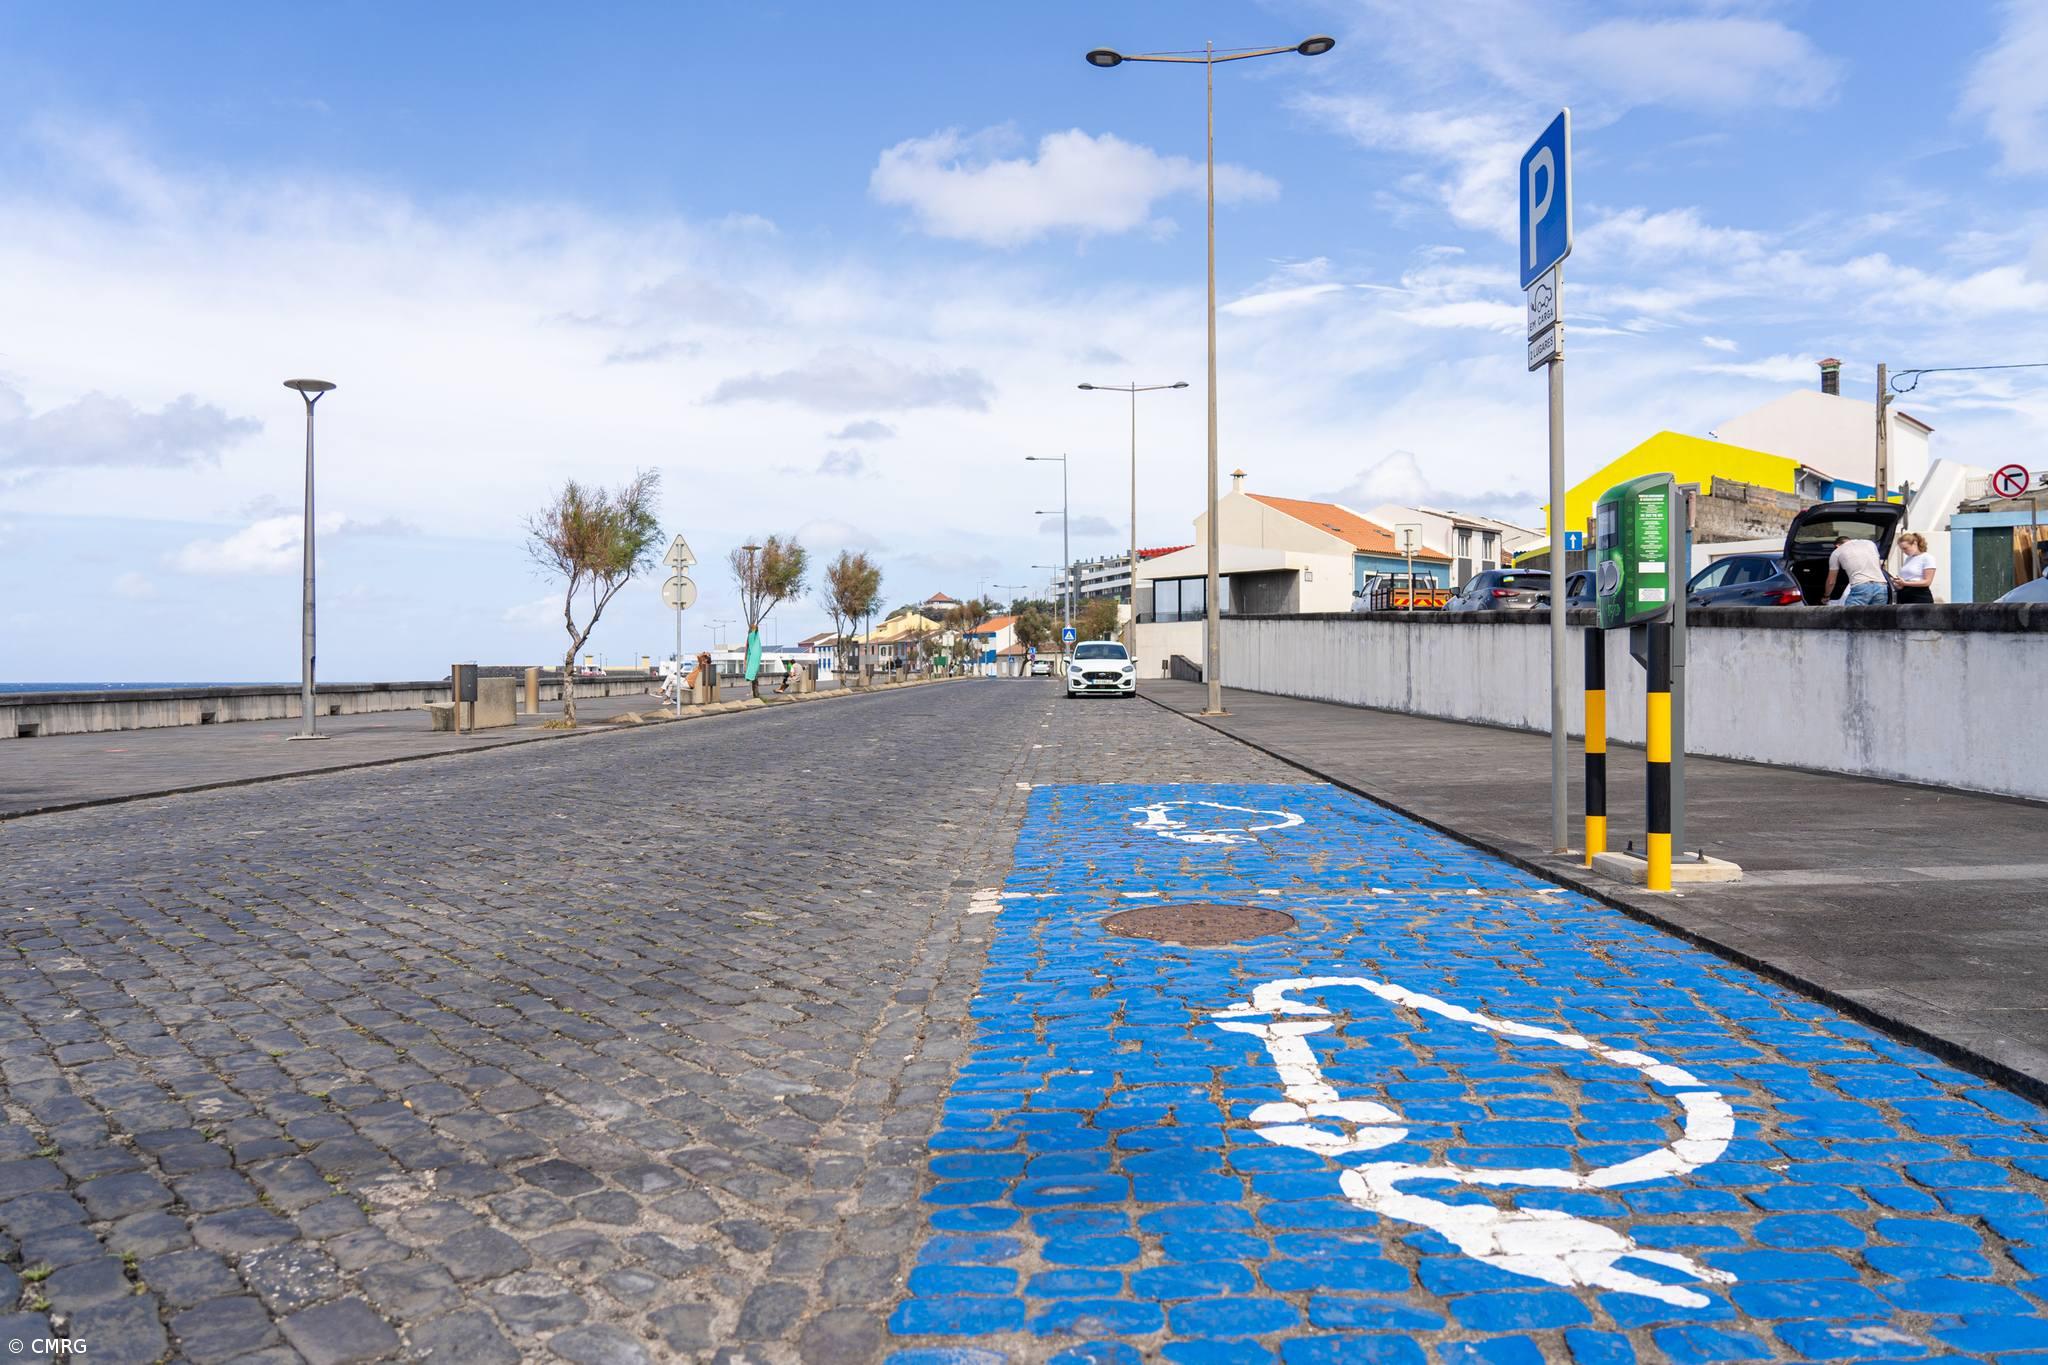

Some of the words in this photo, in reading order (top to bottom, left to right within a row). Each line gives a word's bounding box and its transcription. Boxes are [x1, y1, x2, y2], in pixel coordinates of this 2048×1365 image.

[1528, 146, 1555, 270] P
[1529, 320, 1537, 332] EM
[1538, 308, 1553, 325] CARGA
[1533, 336, 1553, 358] LUGARES
